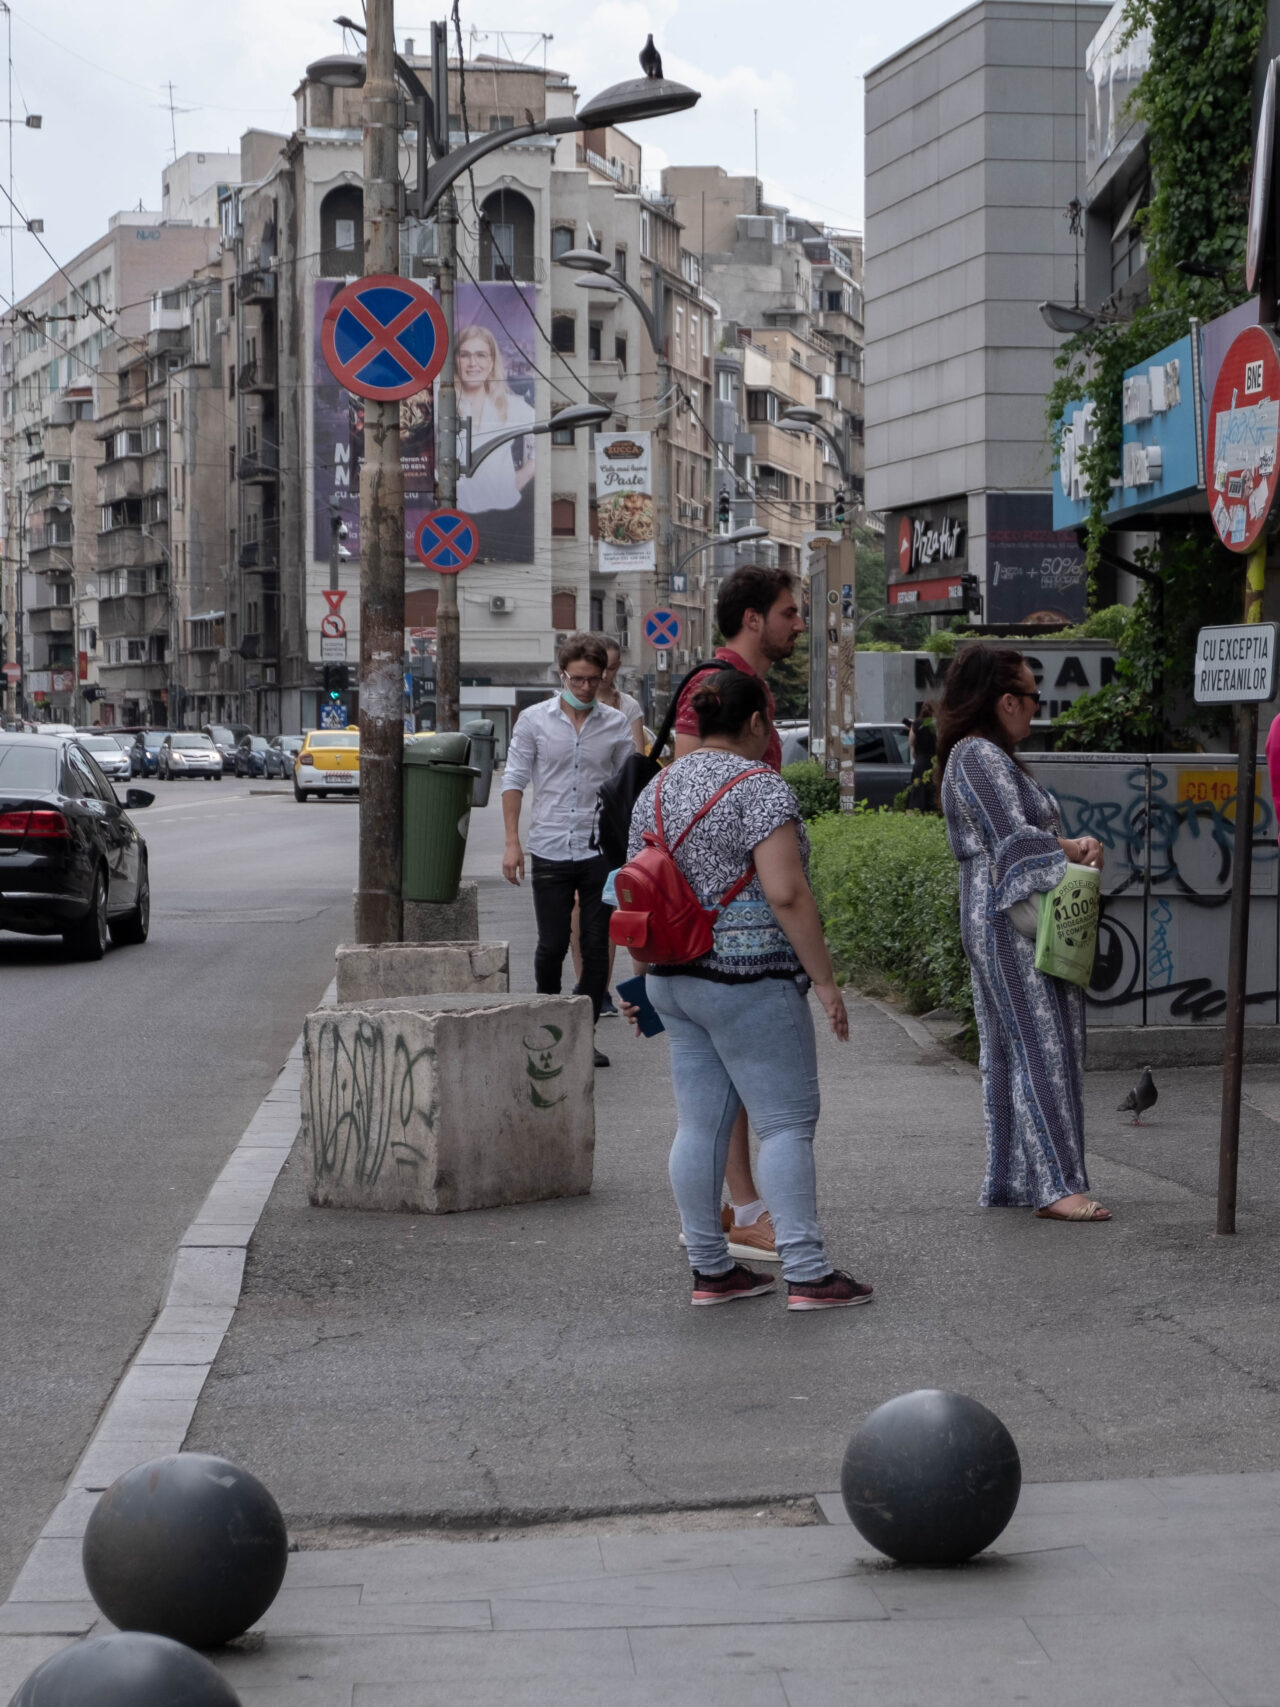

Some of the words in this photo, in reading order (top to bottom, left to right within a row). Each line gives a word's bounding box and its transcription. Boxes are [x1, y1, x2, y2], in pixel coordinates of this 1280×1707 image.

[1246, 363, 1262, 391] BNE
[604, 472, 645, 486] Paste
[911, 519, 940, 569] Pizza
[940, 516, 960, 561] Hut
[1040, 557, 1080, 575] 50%
[1202, 639, 1216, 661] CU
[1200, 667, 1267, 692] RIVERANILOR
